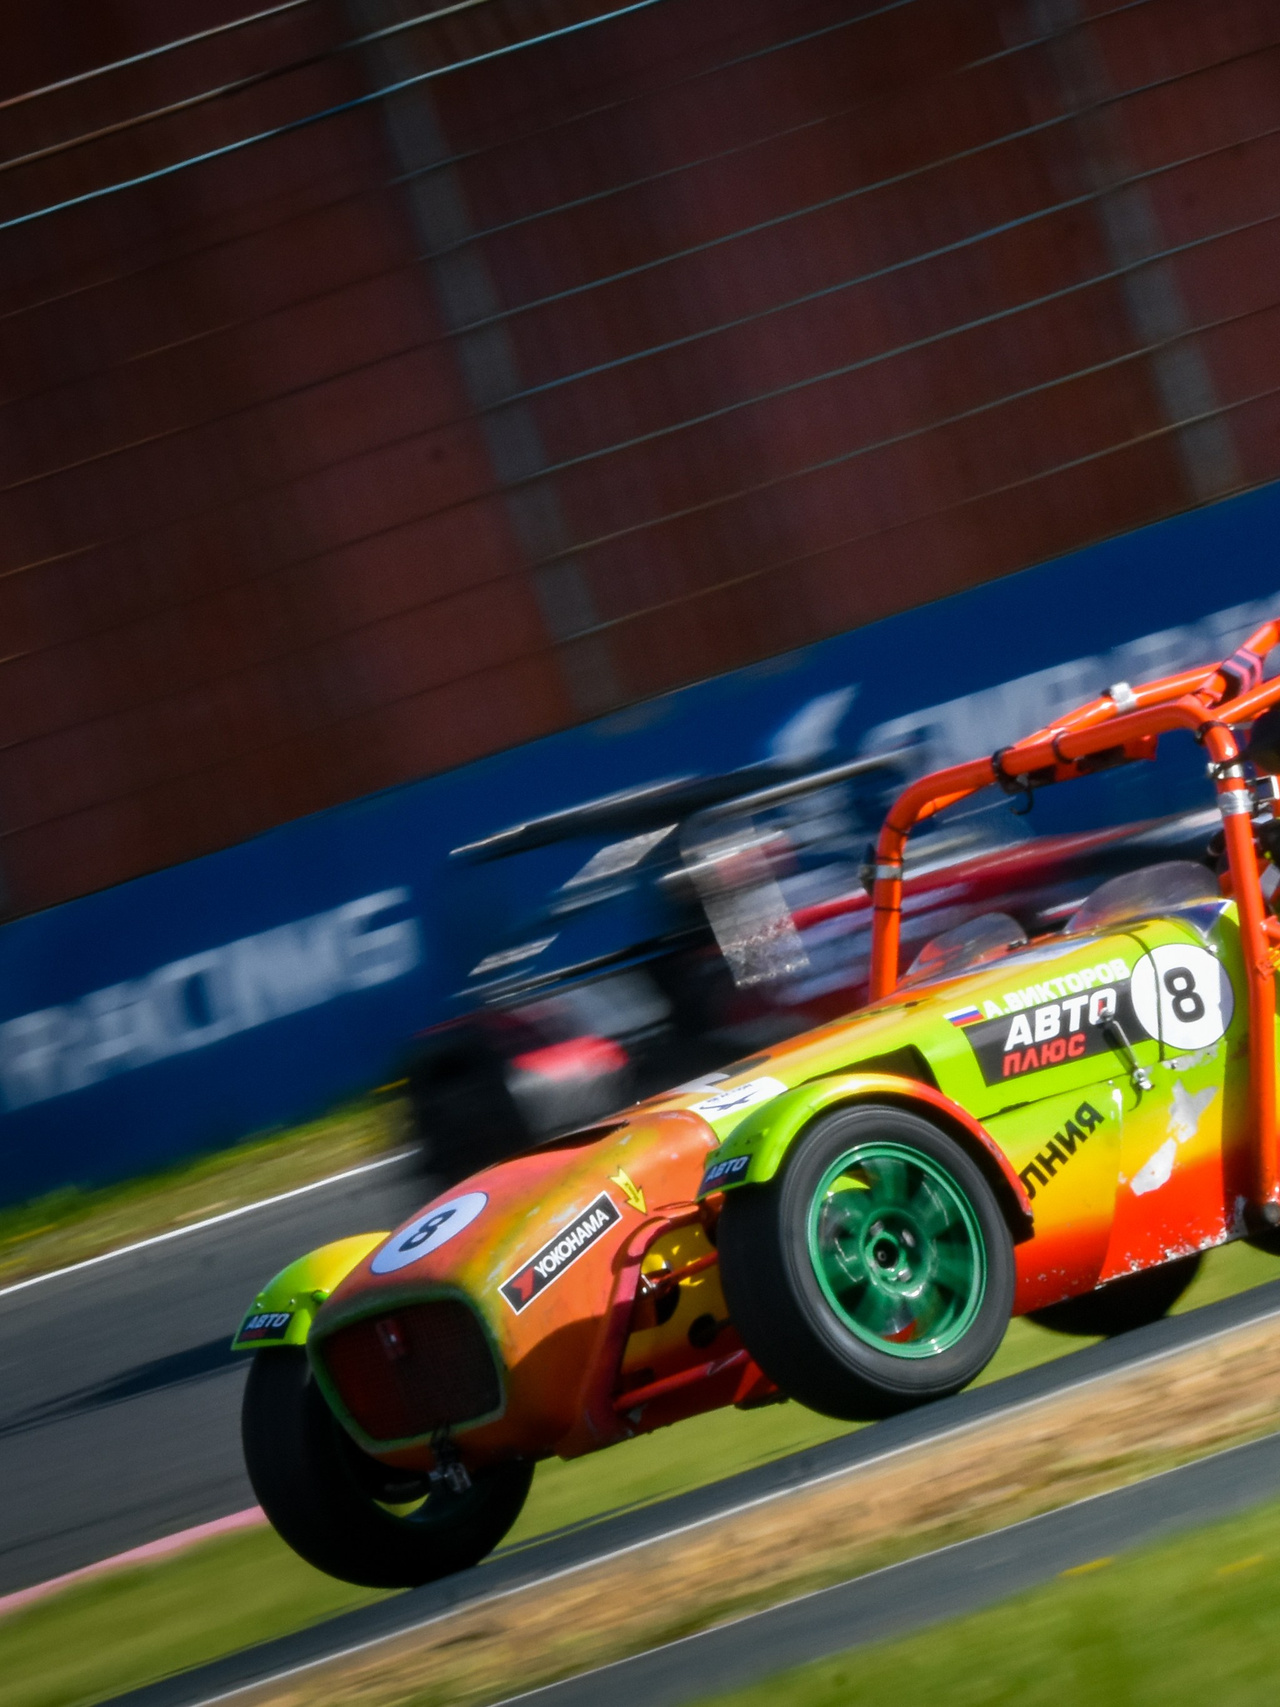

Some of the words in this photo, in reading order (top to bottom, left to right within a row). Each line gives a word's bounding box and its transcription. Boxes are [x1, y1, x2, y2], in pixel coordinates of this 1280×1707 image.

[983, 958, 1130, 1020] А.ВИКТОРОВ
[1163, 966, 1206, 1024] 8
[1003, 988, 1117, 1052] АВТО
[1002, 1032, 1088, 1078] ПЛЮС
[398, 1208, 457, 1253] 8
[534, 1208, 610, 1278] YOKOHAMA
